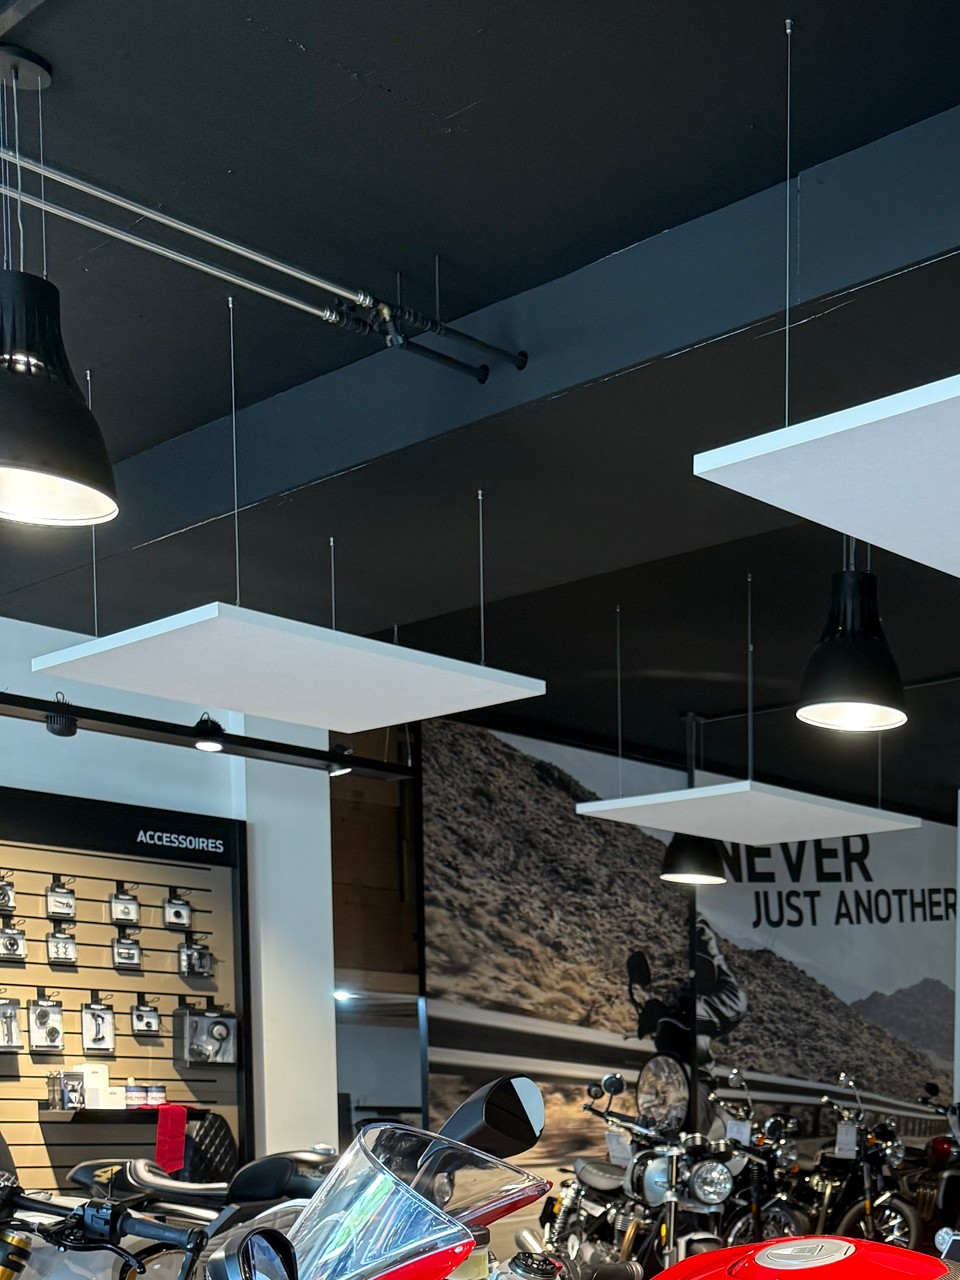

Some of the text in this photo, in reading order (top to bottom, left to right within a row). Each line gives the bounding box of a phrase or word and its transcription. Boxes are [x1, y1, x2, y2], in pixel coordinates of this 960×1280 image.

[137, 829, 224, 853] ACCESSOIRES
[752, 888, 957, 929] JUST ANOTHER
